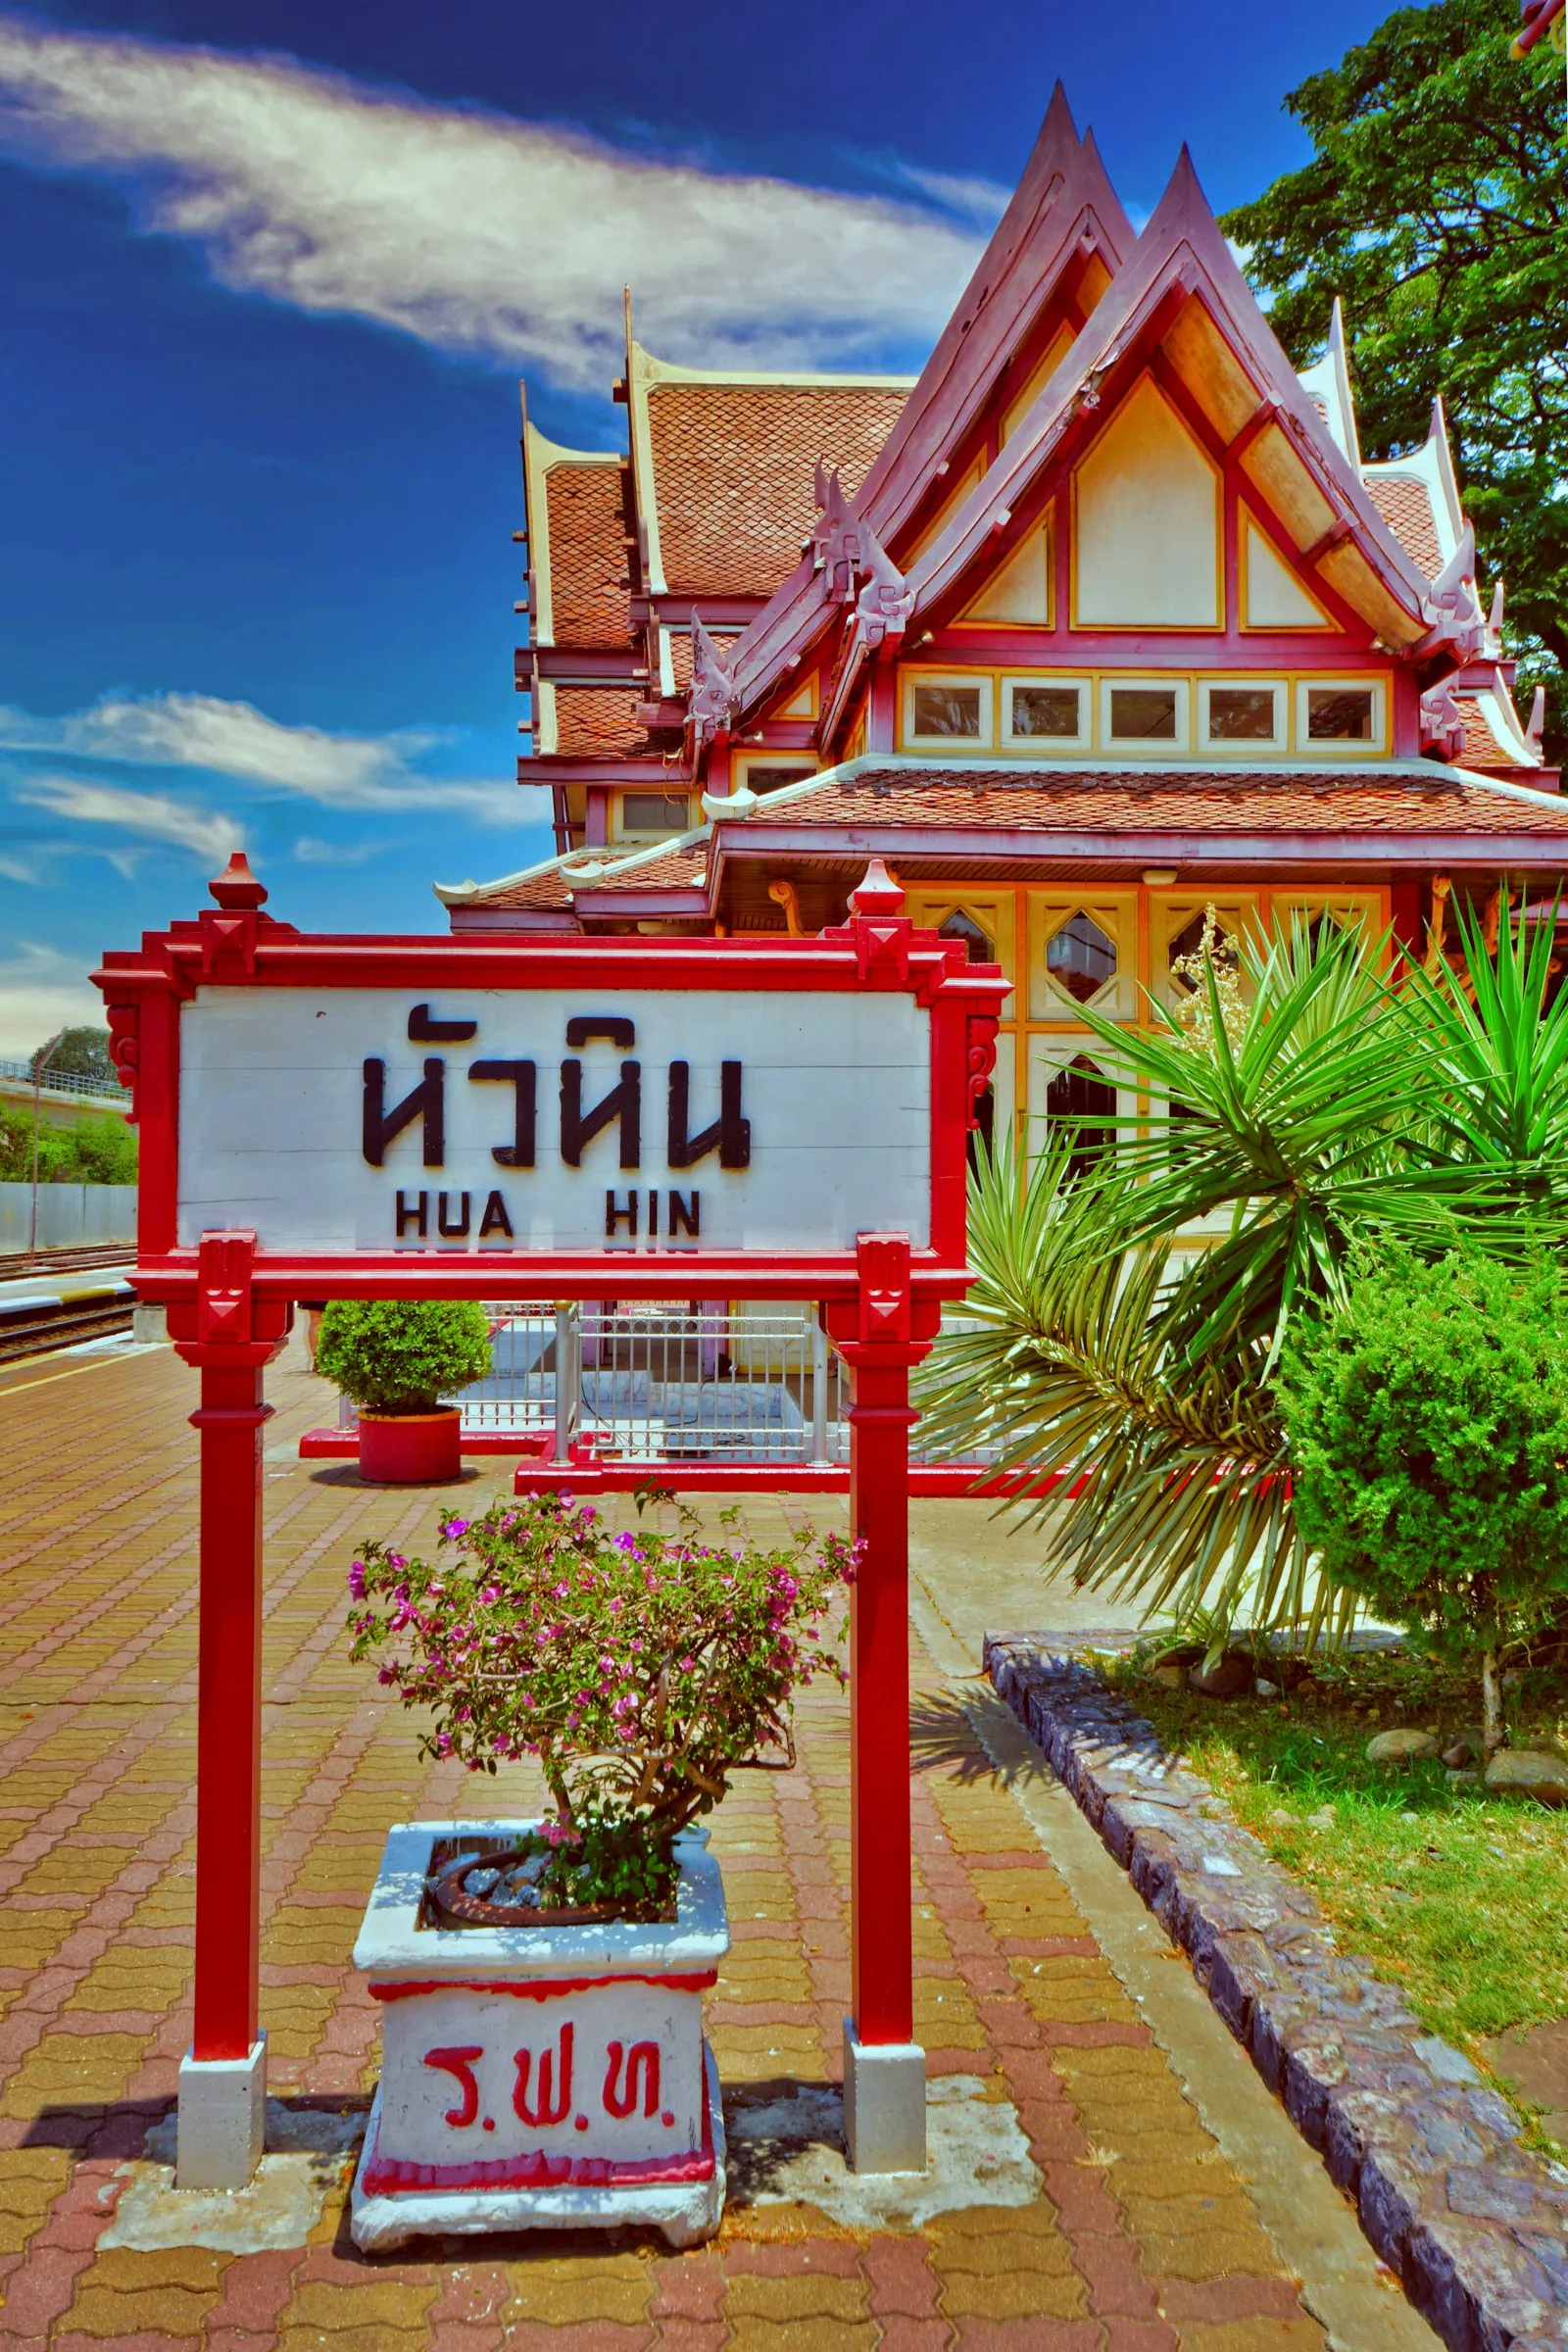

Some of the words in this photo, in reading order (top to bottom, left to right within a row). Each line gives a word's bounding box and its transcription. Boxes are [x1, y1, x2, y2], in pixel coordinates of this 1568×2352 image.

[362, 1004, 752, 1169] หัวหิน
[395, 1190, 514, 1239] HUA
[605, 1190, 700, 1237] HIN
